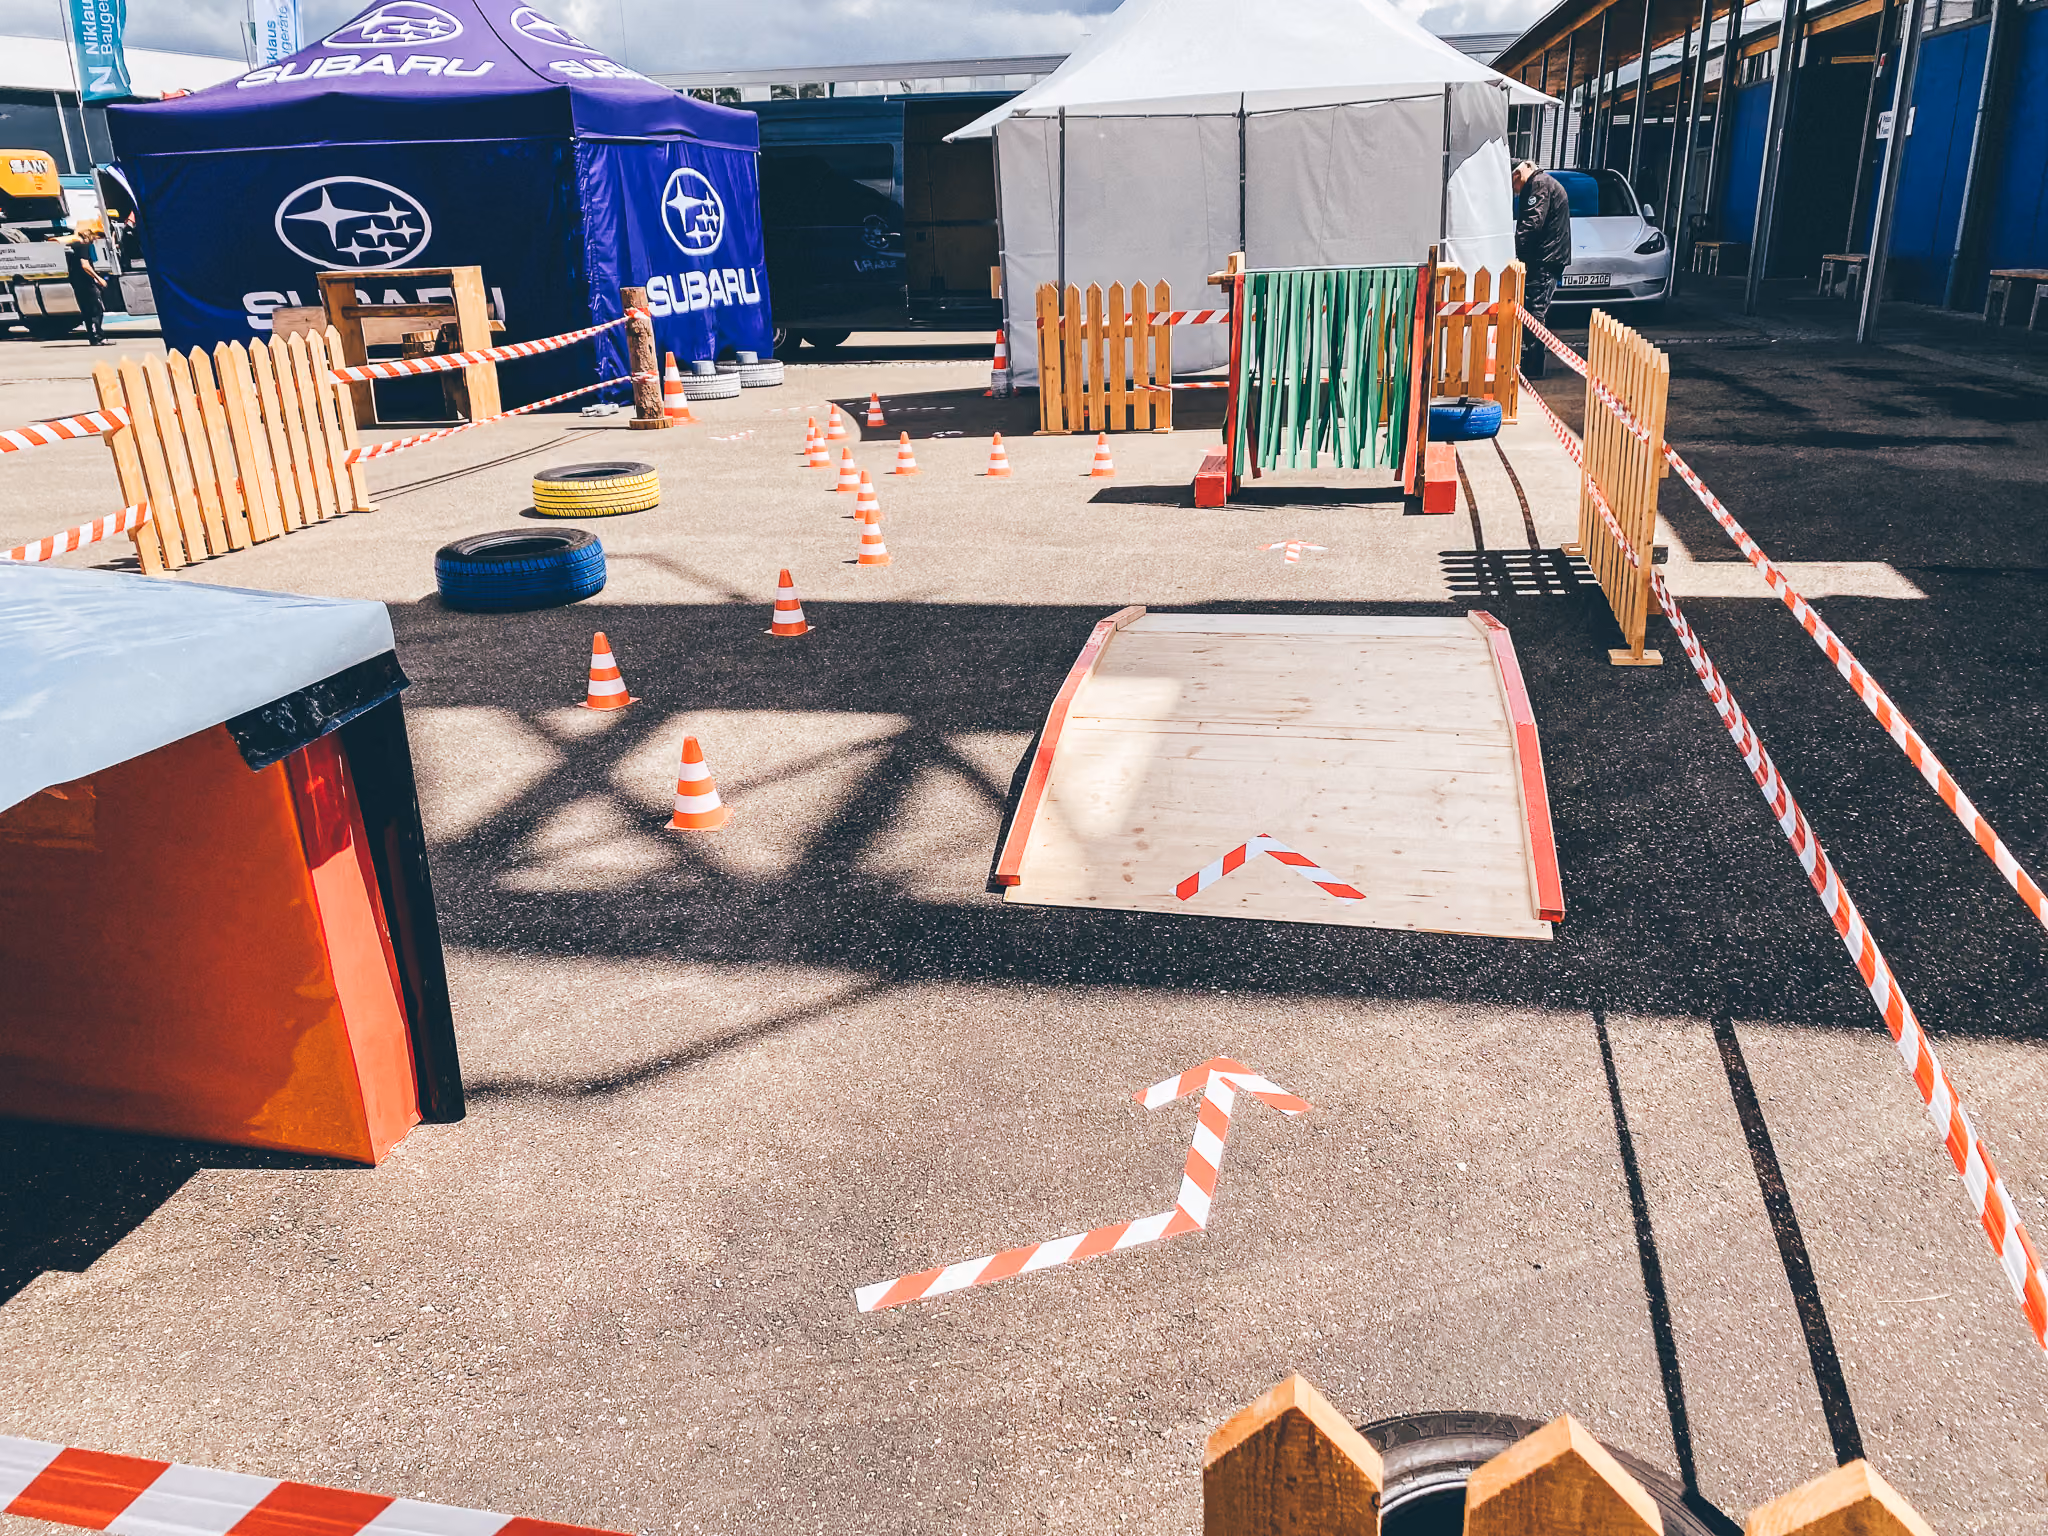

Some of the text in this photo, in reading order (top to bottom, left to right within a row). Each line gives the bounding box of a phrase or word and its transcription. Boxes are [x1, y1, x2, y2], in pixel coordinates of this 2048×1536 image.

[99, 0, 114, 54] Bauge
[266, 20, 278, 64] iklaus
[279, 5, 292, 54] geräte
[236, 53, 495, 89] SUBARU
[646, 268, 761, 317] SUBARU
